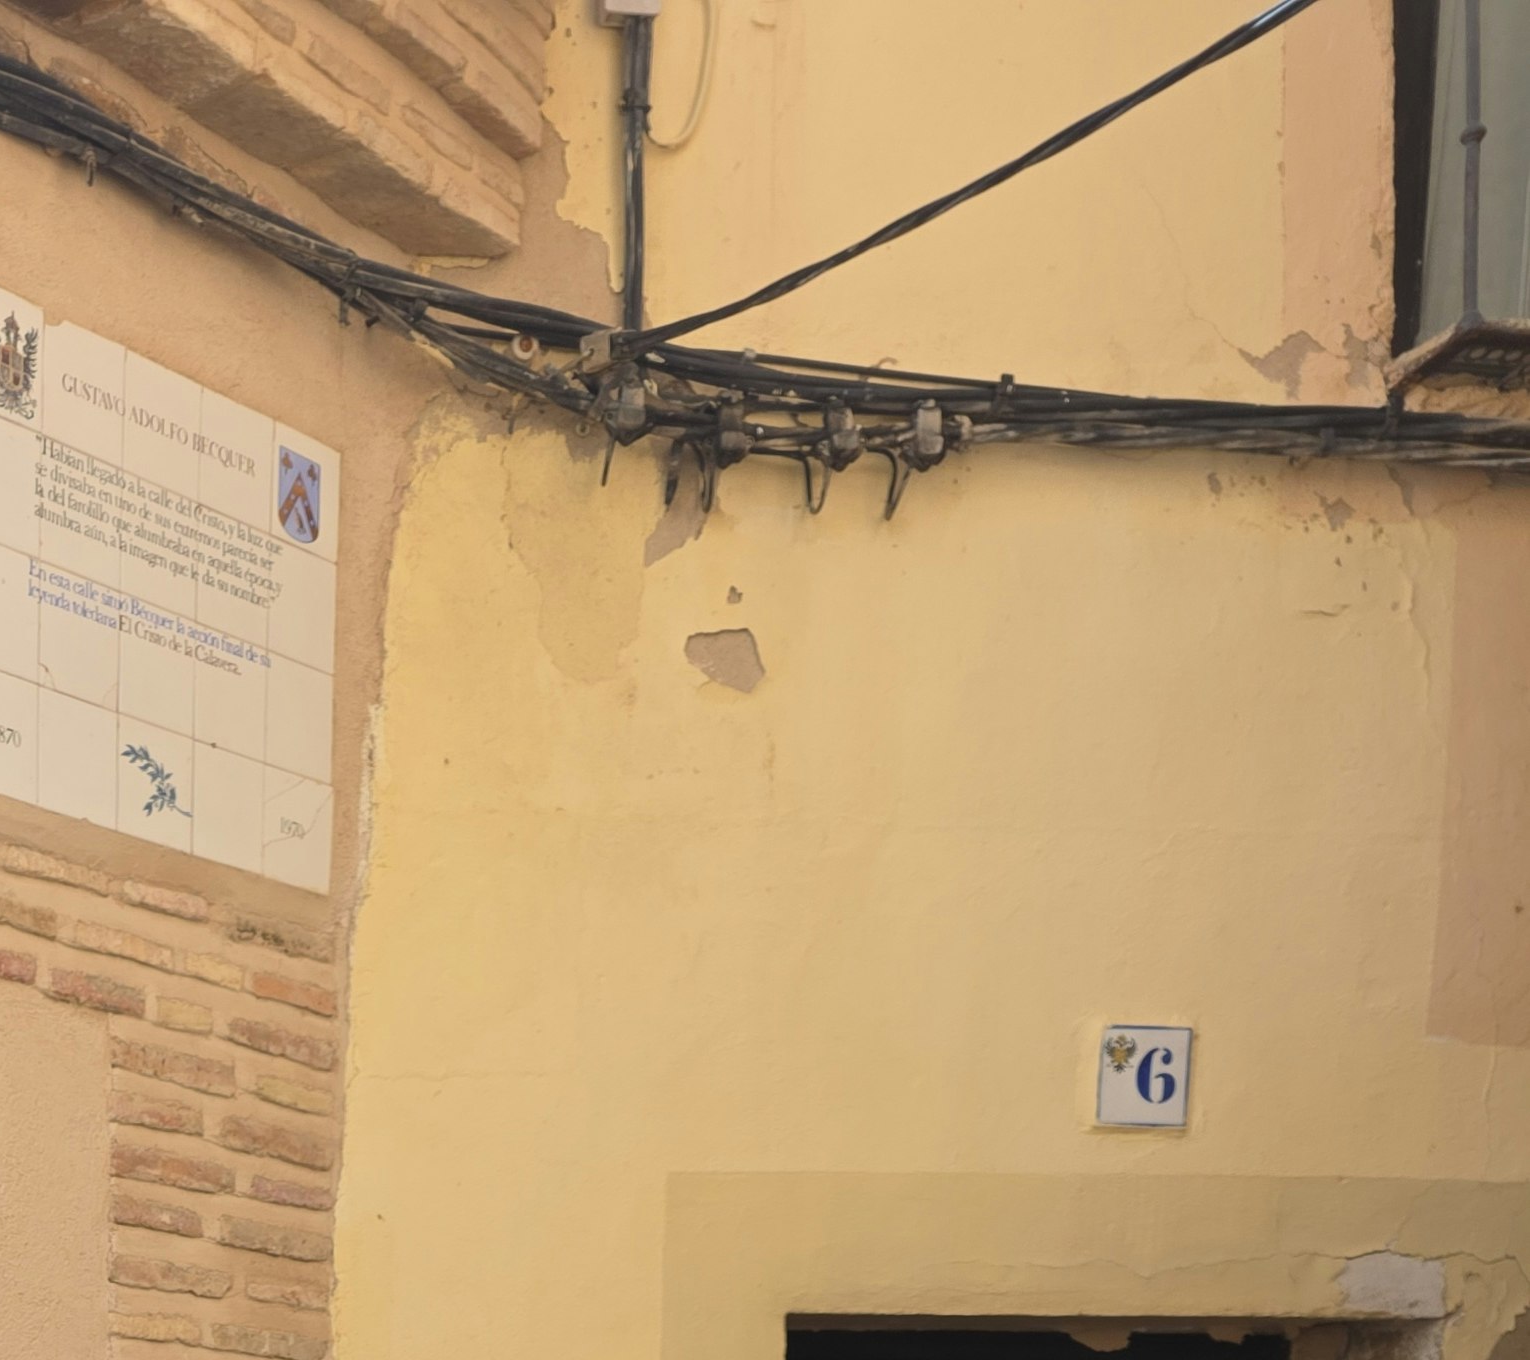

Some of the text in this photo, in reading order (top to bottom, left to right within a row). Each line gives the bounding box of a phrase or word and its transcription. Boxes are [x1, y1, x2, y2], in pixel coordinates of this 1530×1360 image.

[61, 373, 125, 416] GUSTAVO
[129, 406, 188, 444] ADOLFO
[34, 477, 44, 497] la
[47, 485, 65, 506] del
[111, 516, 131, 535] que
[34, 501, 81, 533] alumbra
[109, 535, 116, 548] a
[128, 538, 167, 568] imagen
[168, 561, 189, 579] que
[201, 569, 215, 587] da
[35, 462, 47, 477] se
[49, 464, 95, 497] divisaba
[97, 489, 112, 504] en
[138, 503, 151, 520] de
[259, 557, 274, 571] ser
[127, 481, 135, 493] a
[136, 478, 146, 498] la
[147, 489, 174, 510] calle
[175, 497, 191, 517] del
[246, 527, 263, 548] luz
[264, 539, 285, 557] que
[28, 558, 46, 581] En
[48, 573, 70, 591] esta
[72, 581, 98, 601] calle
[245, 645, 258, 662] de
[28, 578, 70, 611] leyenda
[72, 601, 116, 628] toledana
[118, 614, 130, 633] El
[133, 620, 166, 646] Cristo
[168, 635, 182, 651] de
[184, 639, 192, 657] la
[1136, 1047, 1176, 1104] 6
